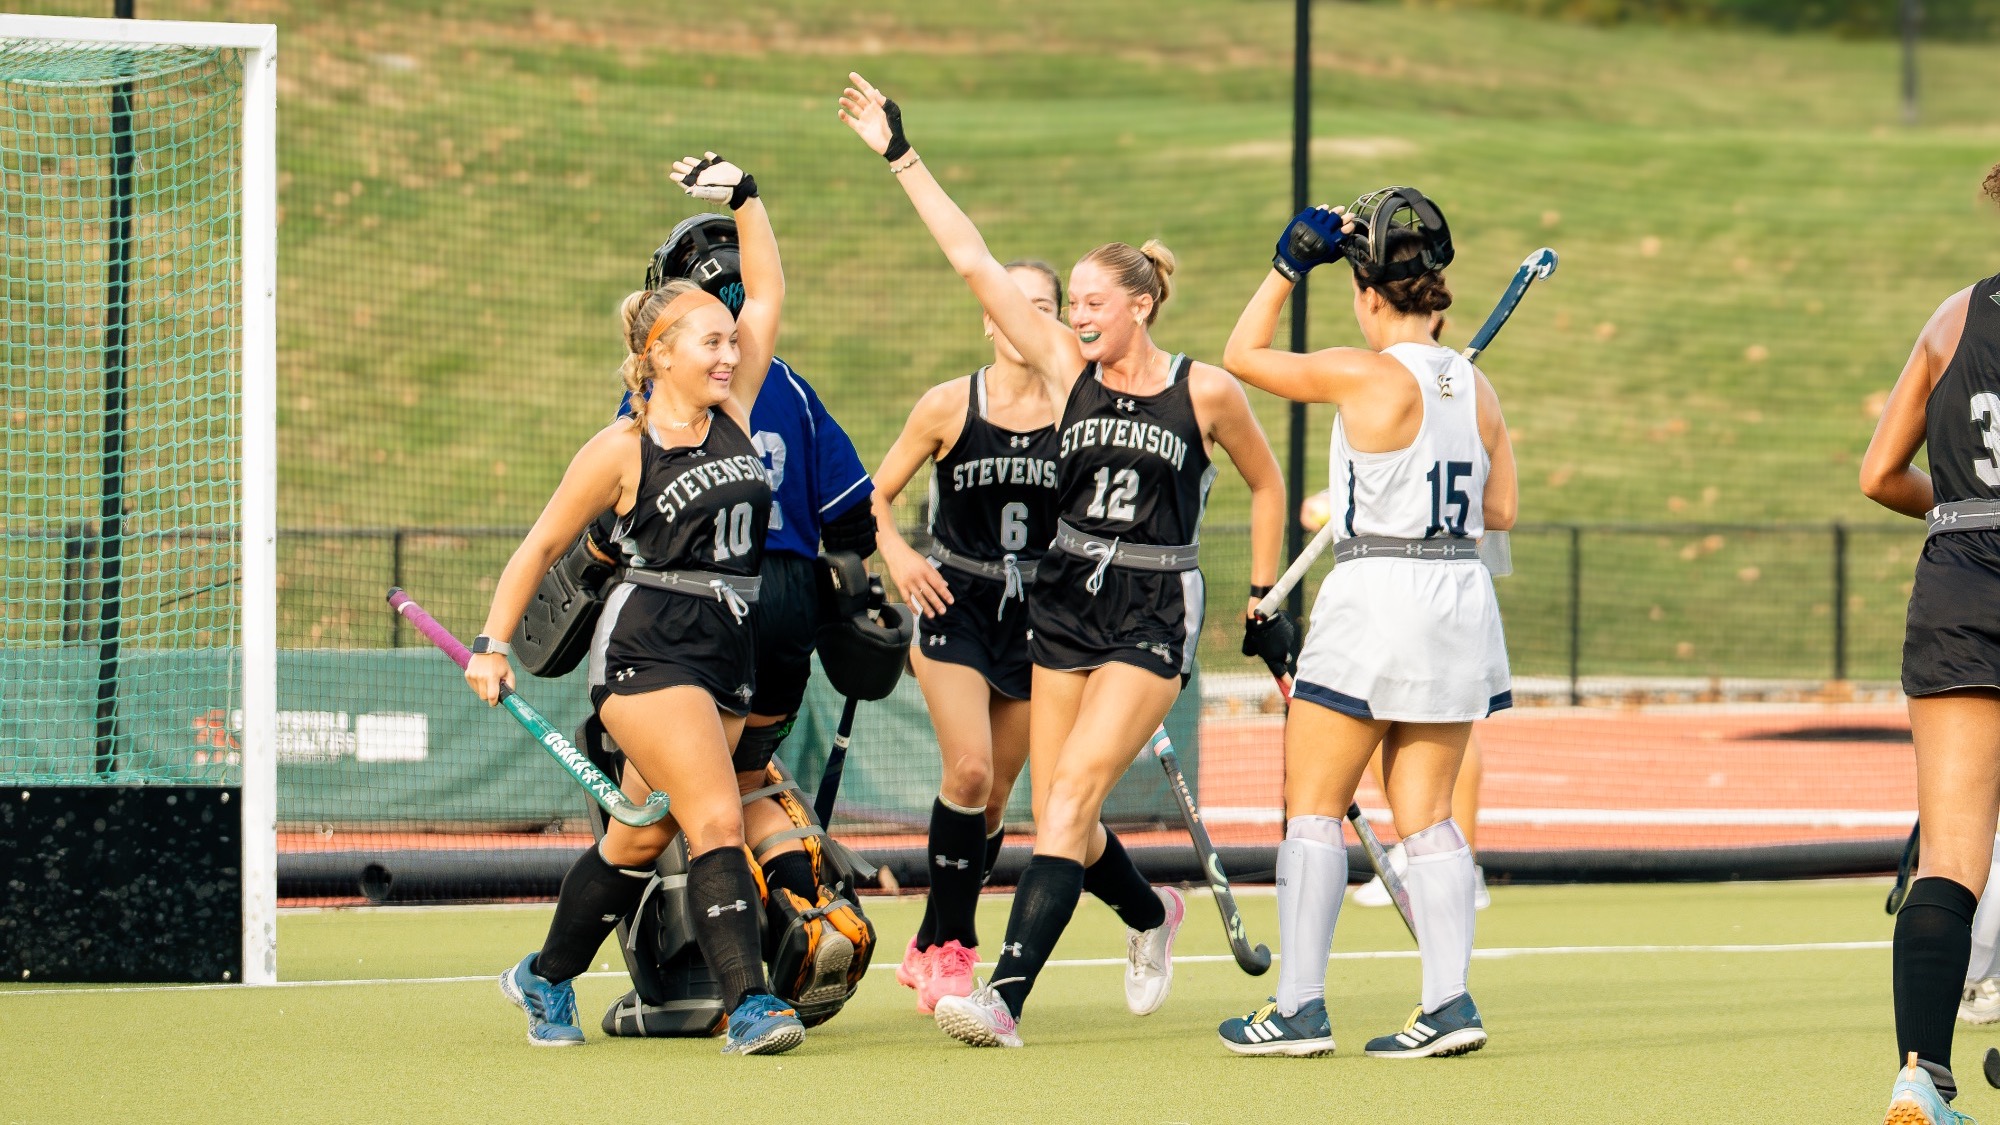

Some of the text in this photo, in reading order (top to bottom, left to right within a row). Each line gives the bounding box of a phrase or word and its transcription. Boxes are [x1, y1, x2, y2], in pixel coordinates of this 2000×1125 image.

[1060, 418, 1187, 471] STEVENSON
[656, 455, 770, 523] STEVENSO
[953, 457, 1058, 491] STEVENS
[1087, 466, 1140, 521] 12
[1424, 461, 1473, 539] 15
[713, 502, 753, 562] 10
[1001, 501, 1029, 551] 6
[544, 732, 592, 775] OSAKA
